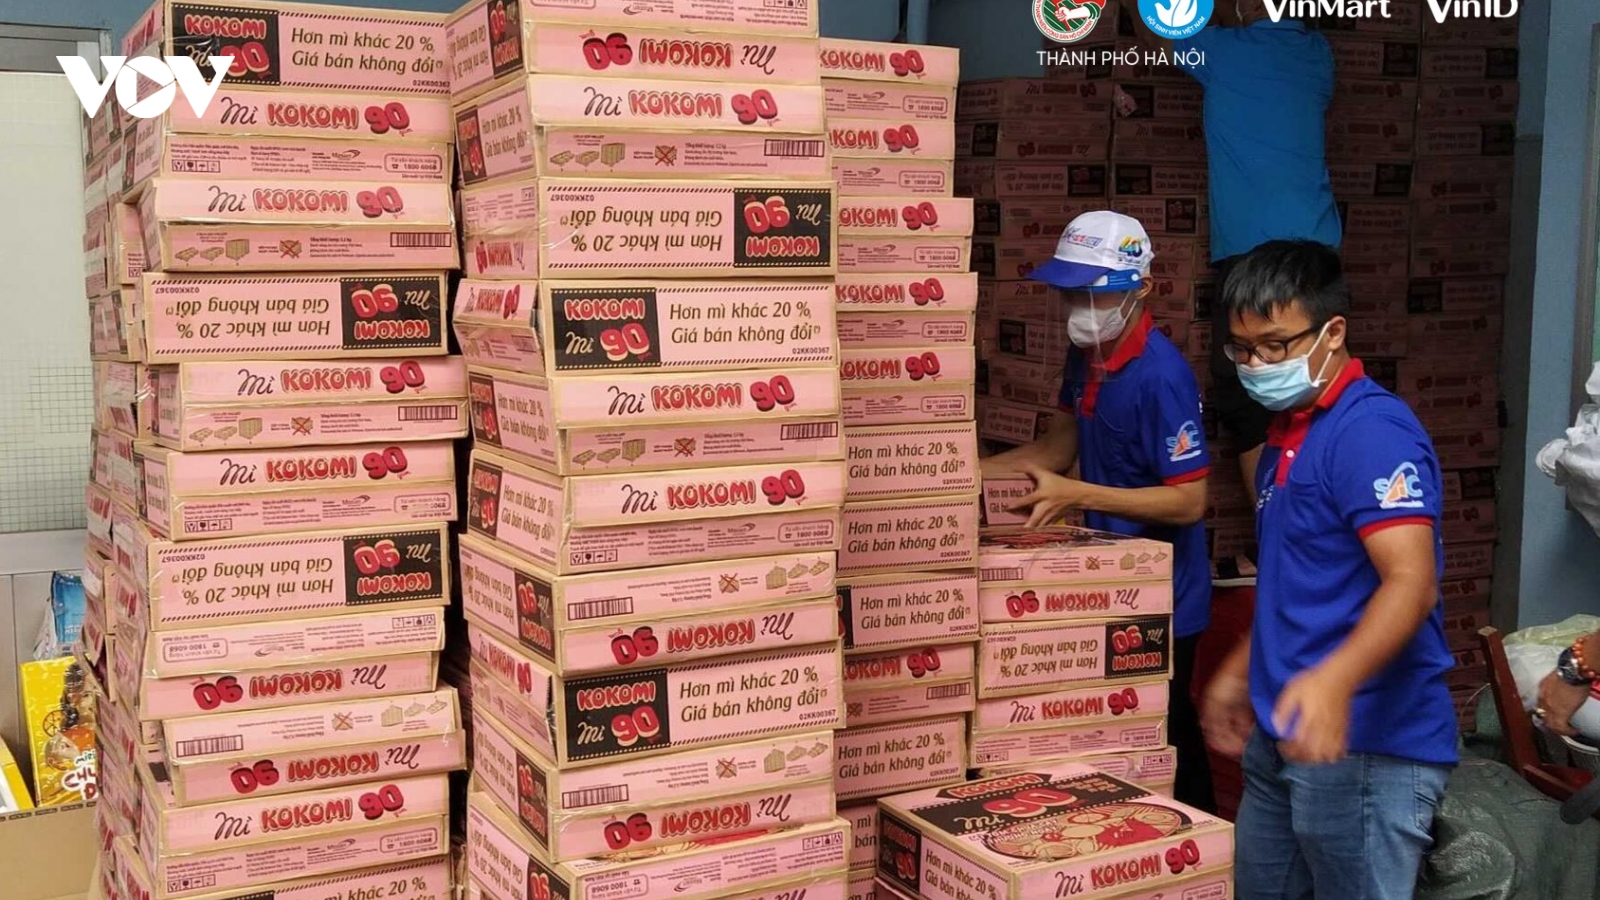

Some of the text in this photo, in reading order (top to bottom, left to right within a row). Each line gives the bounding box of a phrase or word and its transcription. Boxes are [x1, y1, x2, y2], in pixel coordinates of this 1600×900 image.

[185, 15, 267, 39] KOKOMI
[291, 28, 323, 44] Hơn
[329, 32, 348, 46] mì
[354, 32, 391, 48] khác
[395, 35, 414, 50] 20
[292, 50, 318, 67] Giá
[324, 52, 353, 68] bán
[359, 54, 406, 75] không
[583, 33, 632, 70] 90
[640, 38, 733, 68] KOKOMI
[890, 50, 924, 76] 90
[267, 102, 359, 129] KOKOMI
[364, 102, 410, 133] 90
[628, 89, 723, 117] KOKOMI
[731, 89, 778, 124] 90
[253, 189, 348, 215] KOKOMI
[357, 187, 403, 218] 90
[550, 194, 594, 202] 02KK00367
[602, 206, 653, 227] không
[660, 211, 690, 227] bán
[696, 211, 722, 227] Giá
[744, 196, 790, 232] 90
[902, 201, 938, 230] 90
[593, 235, 614, 252] 20
[619, 235, 659, 251] khác
[665, 235, 684, 251] mì
[691, 235, 722, 251] Hơn
[746, 236, 819, 257] KOKOMI
[351, 285, 398, 318] 90
[835, 278, 944, 305] KOKOMI 90
[208, 297, 259, 315] không
[266, 299, 296, 314] bán
[302, 299, 329, 314] Giá
[564, 299, 645, 321] KOKOMI
[670, 304, 701, 320] Hơn
[707, 303, 725, 319] mì
[732, 303, 768, 318] khác
[773, 302, 791, 317] 20
[200, 323, 221, 338] 20
[226, 322, 266, 337] khác
[273, 321, 292, 336] mì
[298, 321, 330, 335] Hơn
[354, 319, 428, 340] KOKOMI
[672, 327, 697, 343] Giá
[704, 327, 732, 343] bán
[738, 326, 785, 344] không
[600, 323, 649, 361] 90
[281, 368, 371, 394] KOKOMI
[380, 361, 425, 393] 90
[905, 352, 940, 380] 90
[651, 383, 742, 412] KOKOMI
[750, 375, 795, 412] 90
[848, 446, 872, 459] Hơn
[877, 445, 891, 458] mì
[896, 444, 924, 457] khác
[927, 442, 942, 455] 20
[266, 456, 357, 482] KOKOMI
[362, 447, 408, 478] 90
[849, 465, 869, 478] Giá
[874, 464, 896, 477] bán
[901, 462, 937, 477] không
[667, 481, 756, 510] KOKOMI
[762, 469, 805, 505] 90
[1006, 590, 1039, 618] 90
[1045, 592, 1110, 613] KOKOMI
[610, 626, 659, 665] 90
[667, 619, 755, 652] KOKOMI
[1112, 626, 1142, 652] 90
[1113, 652, 1161, 669] KOKOMI
[192, 676, 243, 710] 90
[250, 669, 342, 698] KOKOMI
[1042, 697, 1104, 720] KOKOMI
[1108, 688, 1139, 717] 90
[230, 759, 279, 794] 90
[287, 752, 378, 781] KOKOMI
[951, 773, 1043, 797] KOKOMI
[261, 799, 352, 832] KOKOMI
[358, 784, 403, 820] 90
[983, 788, 1078, 817] 90
[604, 812, 652, 850] 90
[661, 802, 751, 838] KOKOMI
[1091, 853, 1161, 890] KOKOMI
[1165, 839, 1199, 873] 90
